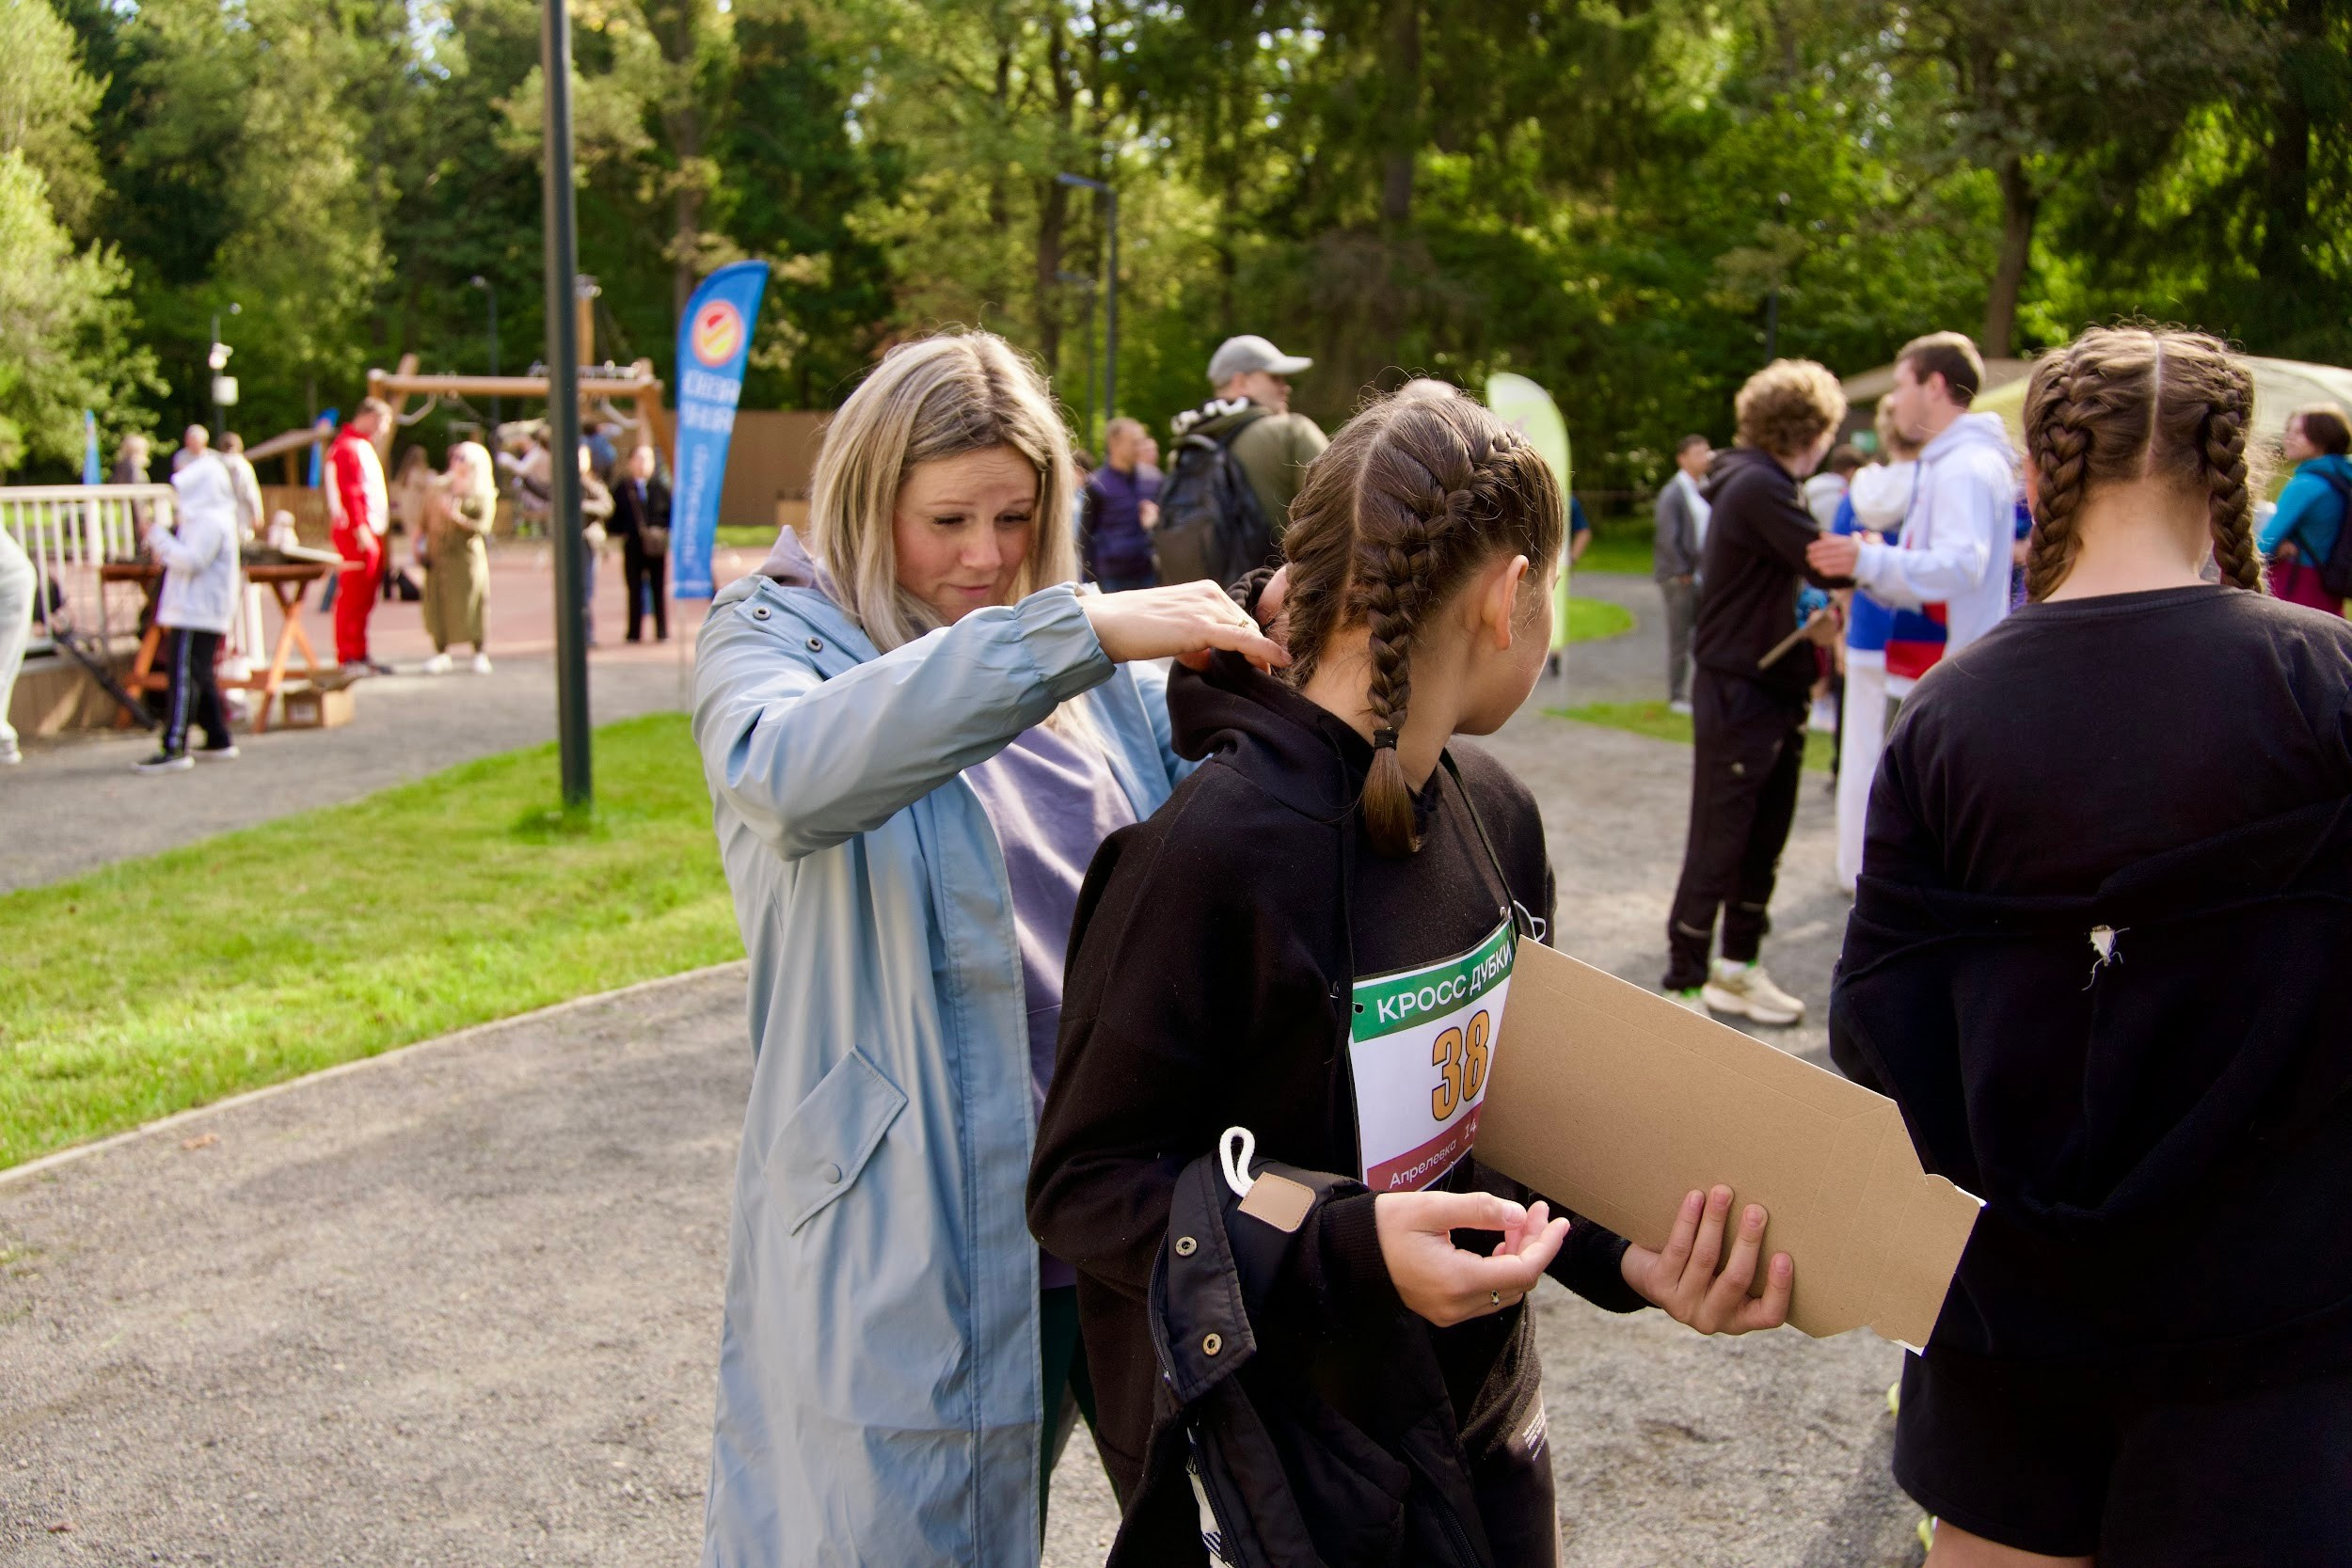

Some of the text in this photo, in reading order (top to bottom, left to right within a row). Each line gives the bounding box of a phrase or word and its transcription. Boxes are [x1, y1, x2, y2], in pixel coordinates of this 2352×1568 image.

[1376, 940, 1513, 1023] КРОСС ДУБКИ
[1431, 1008, 1490, 1121] 38
[1389, 1138, 1457, 1189] Апрелевка
